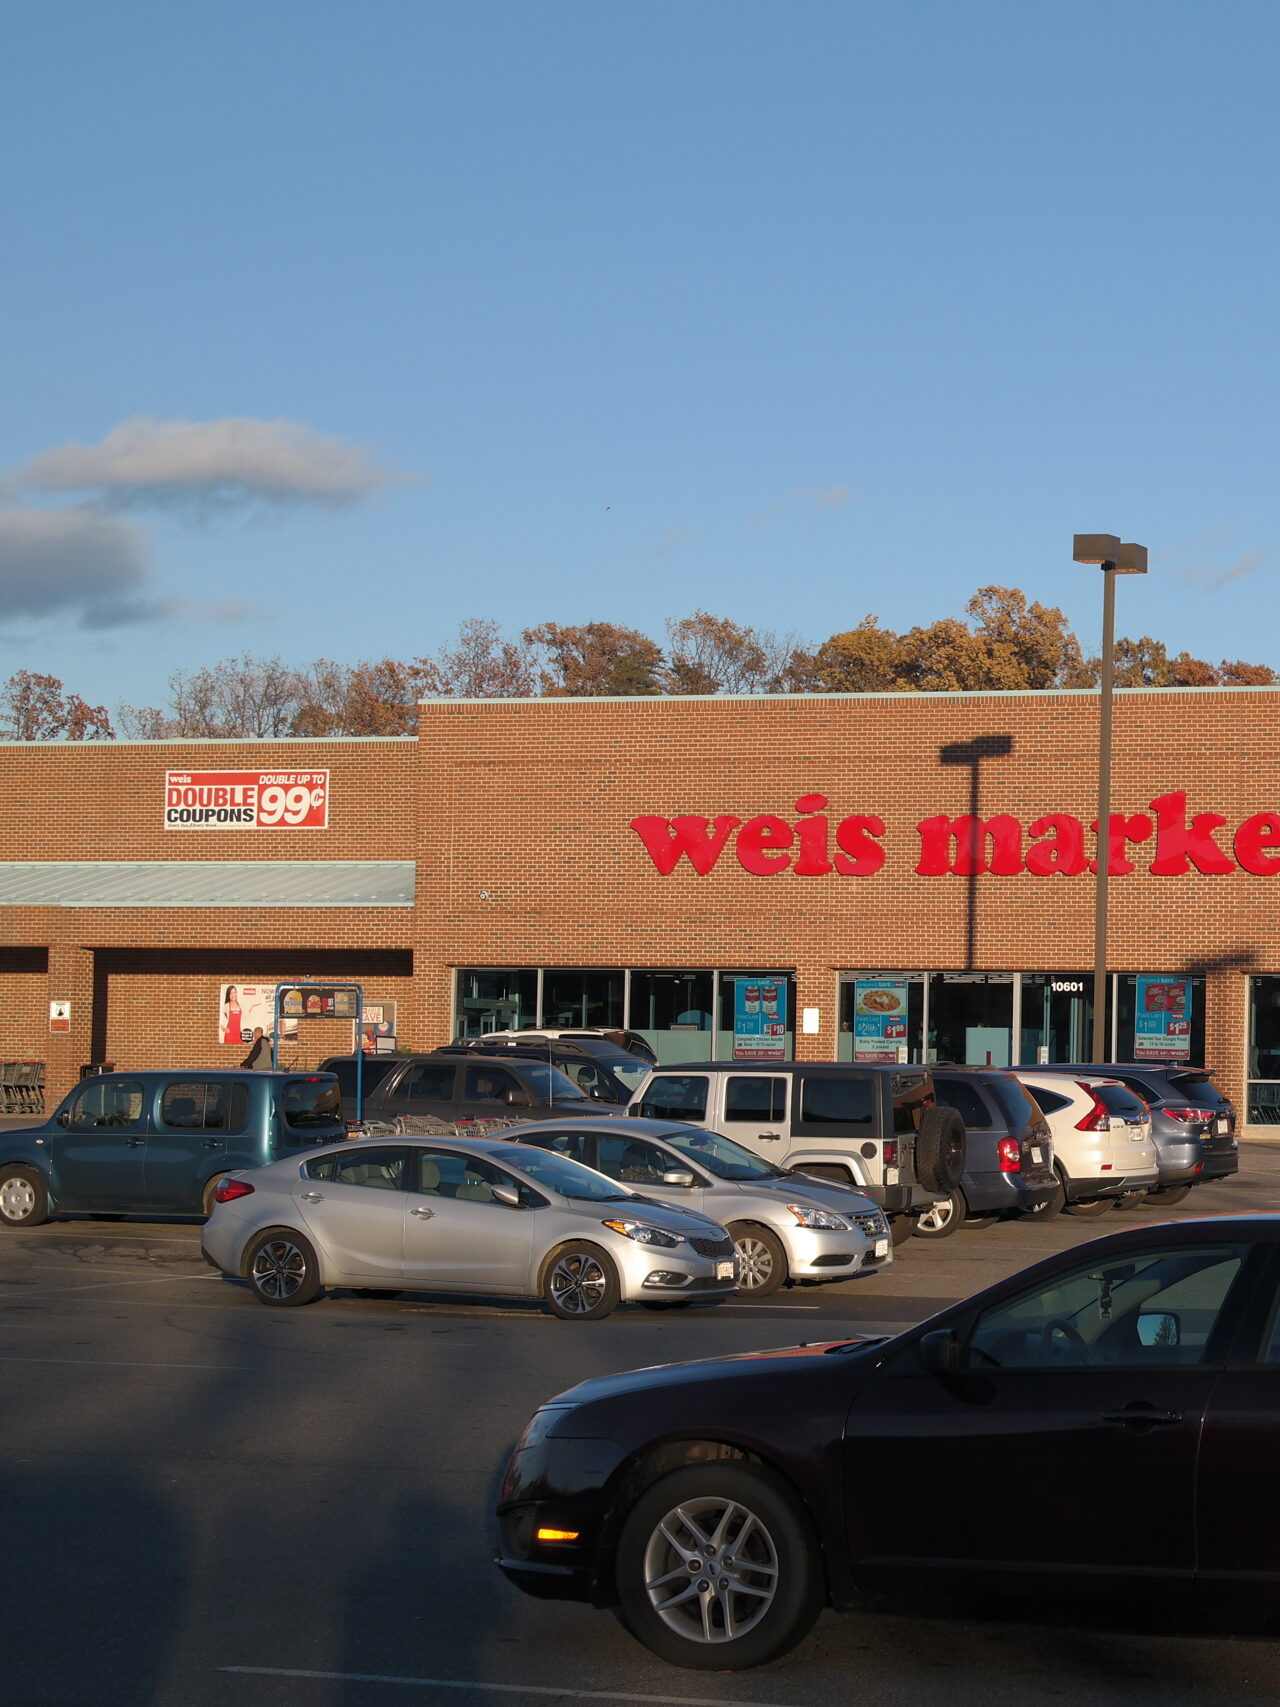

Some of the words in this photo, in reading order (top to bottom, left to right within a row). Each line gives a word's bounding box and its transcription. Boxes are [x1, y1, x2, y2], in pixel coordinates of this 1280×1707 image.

[169, 774, 192, 784] weis
[259, 775, 296, 785] DOUBLE
[297, 774, 311, 784] UP
[312, 774, 325, 784] TO
[167, 786, 255, 808] DOUBLE
[258, 786, 325, 825] 99¢
[167, 808, 254, 823] COUPONS
[630, 794, 886, 877] weis
[1051, 982, 1084, 992] 10601
